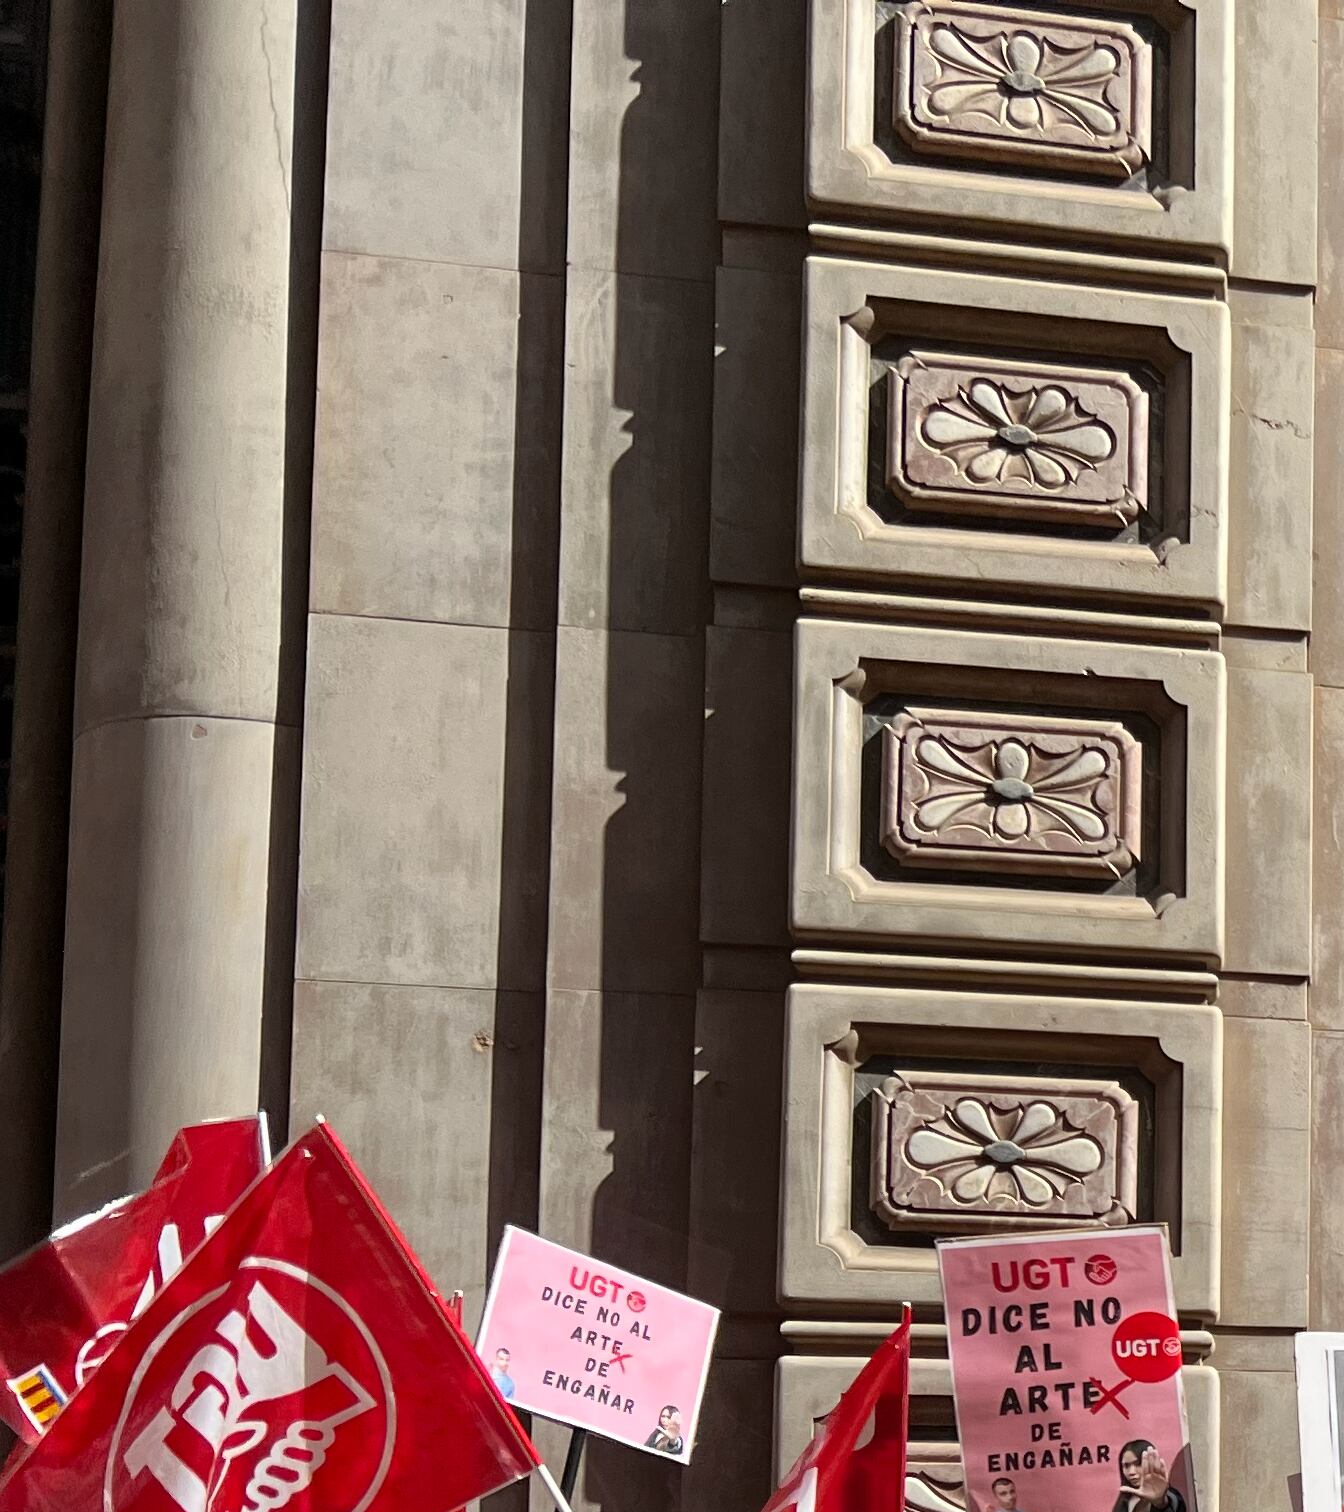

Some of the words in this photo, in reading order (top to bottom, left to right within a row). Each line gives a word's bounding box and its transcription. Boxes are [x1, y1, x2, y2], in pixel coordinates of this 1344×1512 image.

[569, 1266, 624, 1303] UGT
[992, 1257, 1075, 1293] UGT
[541, 1286, 588, 1315] DICE
[597, 1306, 621, 1327] NO
[630, 1321, 651, 1341] AL
[962, 1302, 1050, 1336] DICE
[1073, 1296, 1121, 1328] NO
[570, 1326, 623, 1356] ARTE
[1115, 1339, 1161, 1358] UGT
[585, 1357, 610, 1378] DE
[1015, 1343, 1063, 1373] AL
[542, 1370, 636, 1415] ENGAÑAR
[1000, 1380, 1102, 1416] ARTE
[1031, 1422, 1062, 1443] DE
[987, 1442, 1111, 1473] ENGAÑAR
